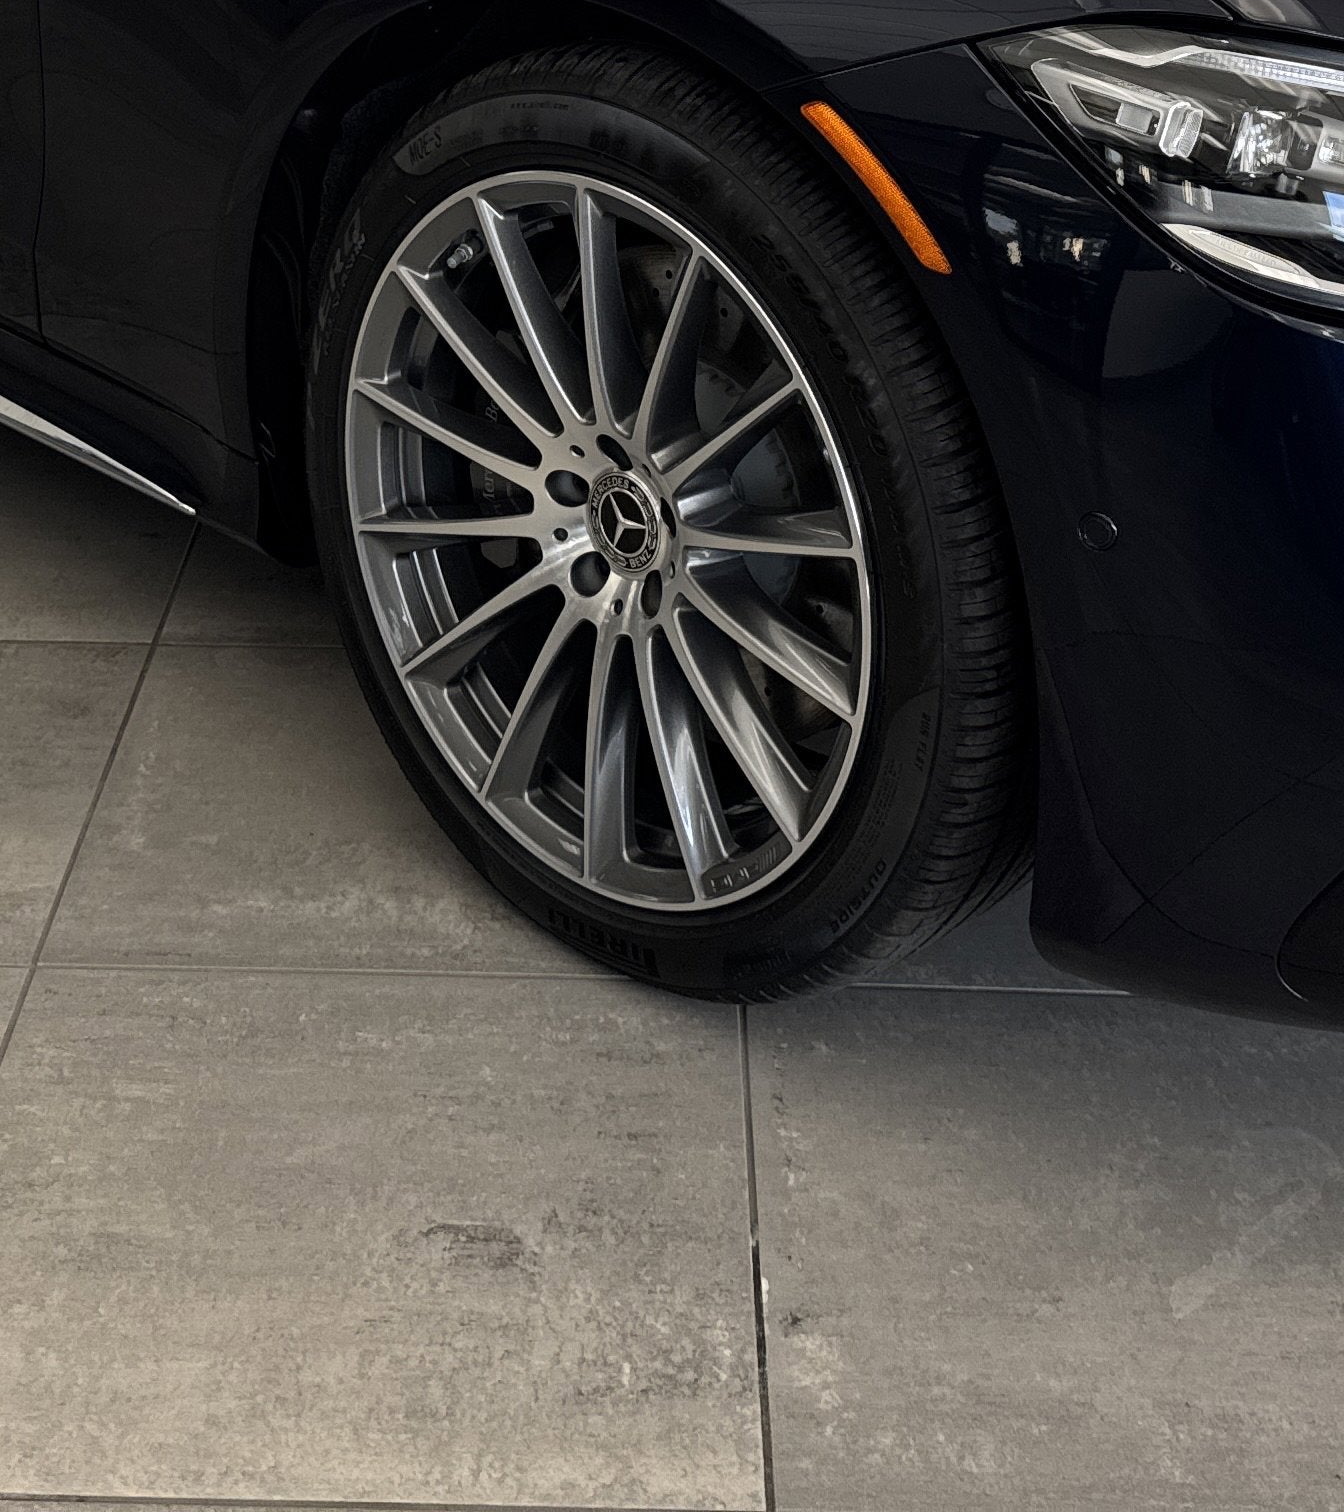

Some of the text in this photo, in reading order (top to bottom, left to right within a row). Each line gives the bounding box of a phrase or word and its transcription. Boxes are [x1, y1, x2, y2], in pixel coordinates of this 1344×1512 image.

[591, 476, 630, 508] MERCEDES
[629, 548, 652, 568] BENZ
[547, 907, 660, 978] PIRELLI
